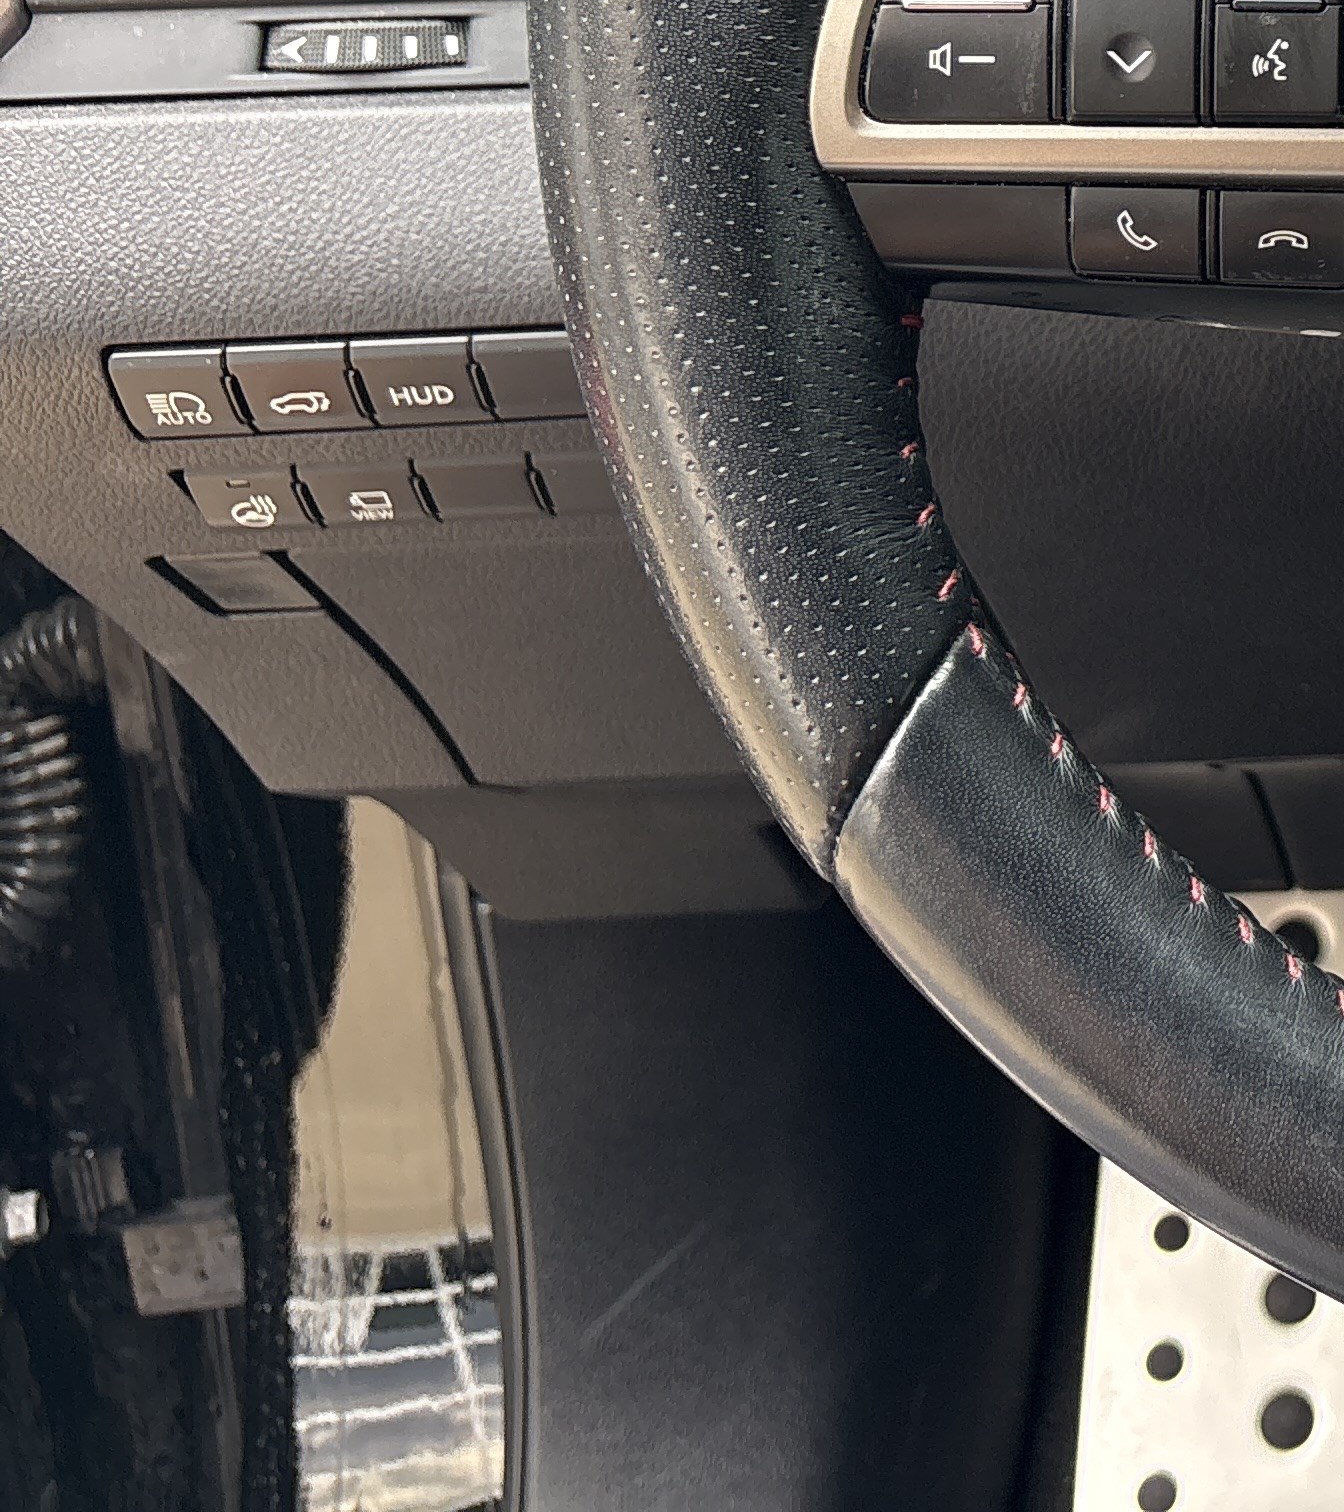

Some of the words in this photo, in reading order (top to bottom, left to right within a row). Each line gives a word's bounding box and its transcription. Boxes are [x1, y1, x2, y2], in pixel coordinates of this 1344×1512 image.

[389, 384, 455, 408] HUD
[155, 409, 213, 427] AUTO
[349, 509, 394, 523] VIEW
